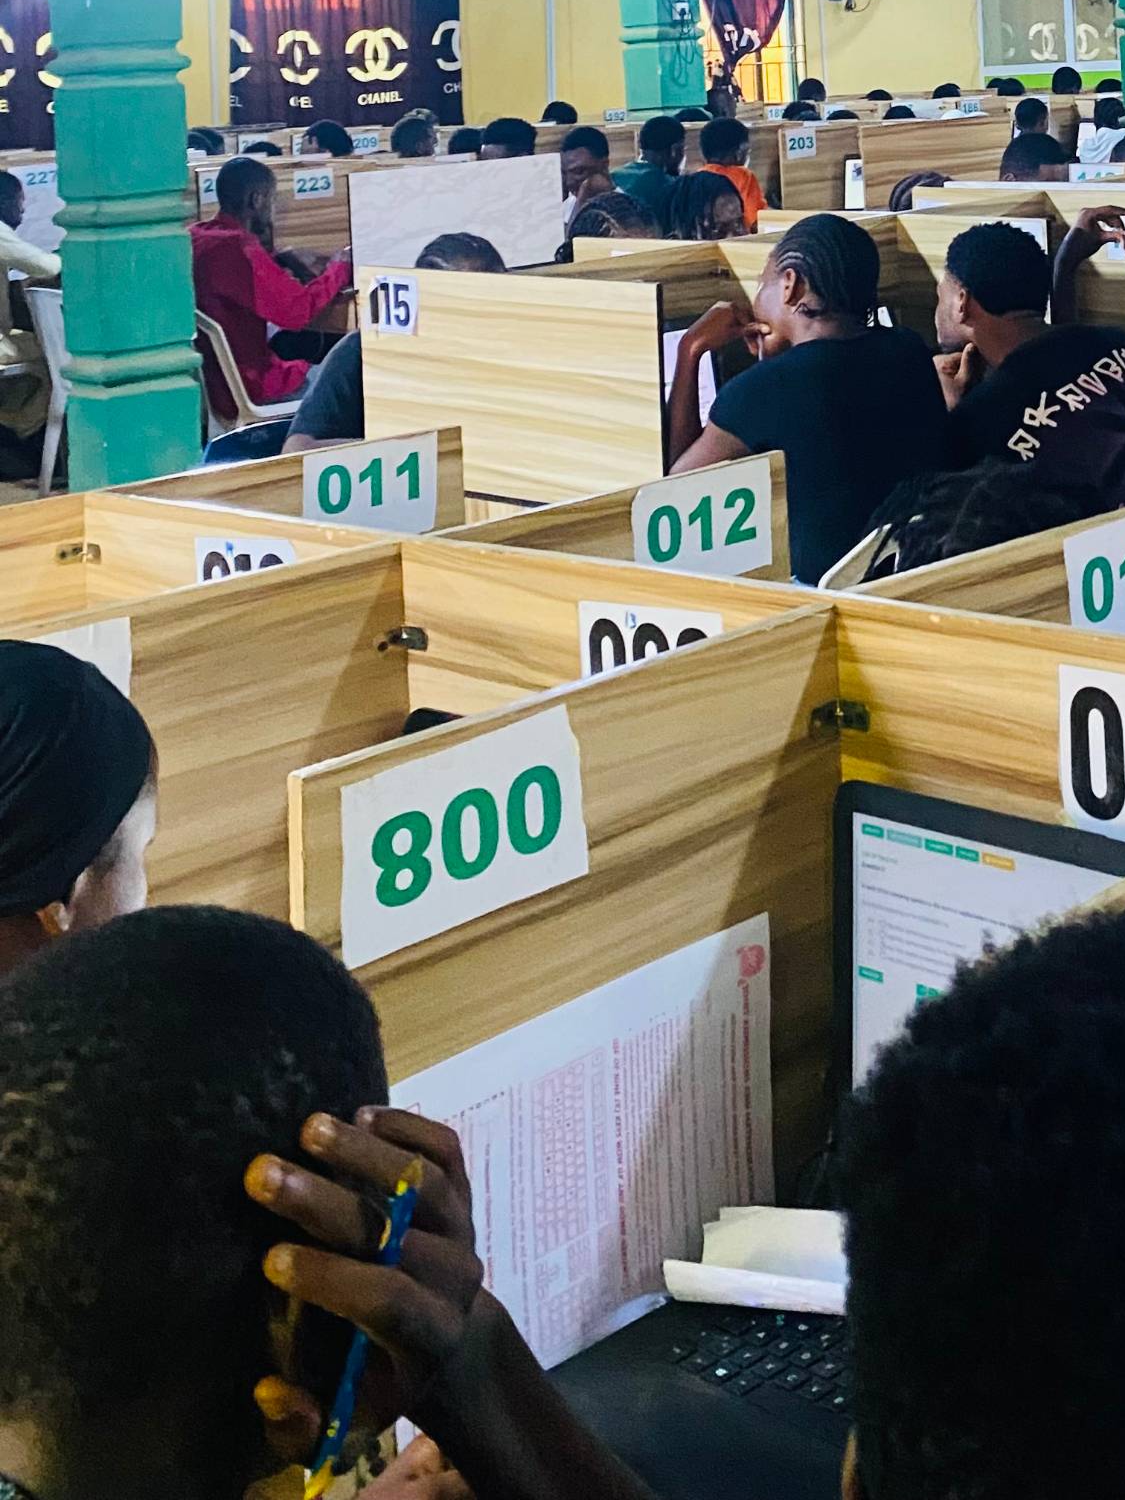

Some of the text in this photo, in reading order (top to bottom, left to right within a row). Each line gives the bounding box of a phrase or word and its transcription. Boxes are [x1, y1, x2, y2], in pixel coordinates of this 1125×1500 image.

[788, 136, 814, 150] 203
[296, 175, 331, 193] 223
[317, 451, 420, 515] 011
[647, 487, 757, 563] 012
